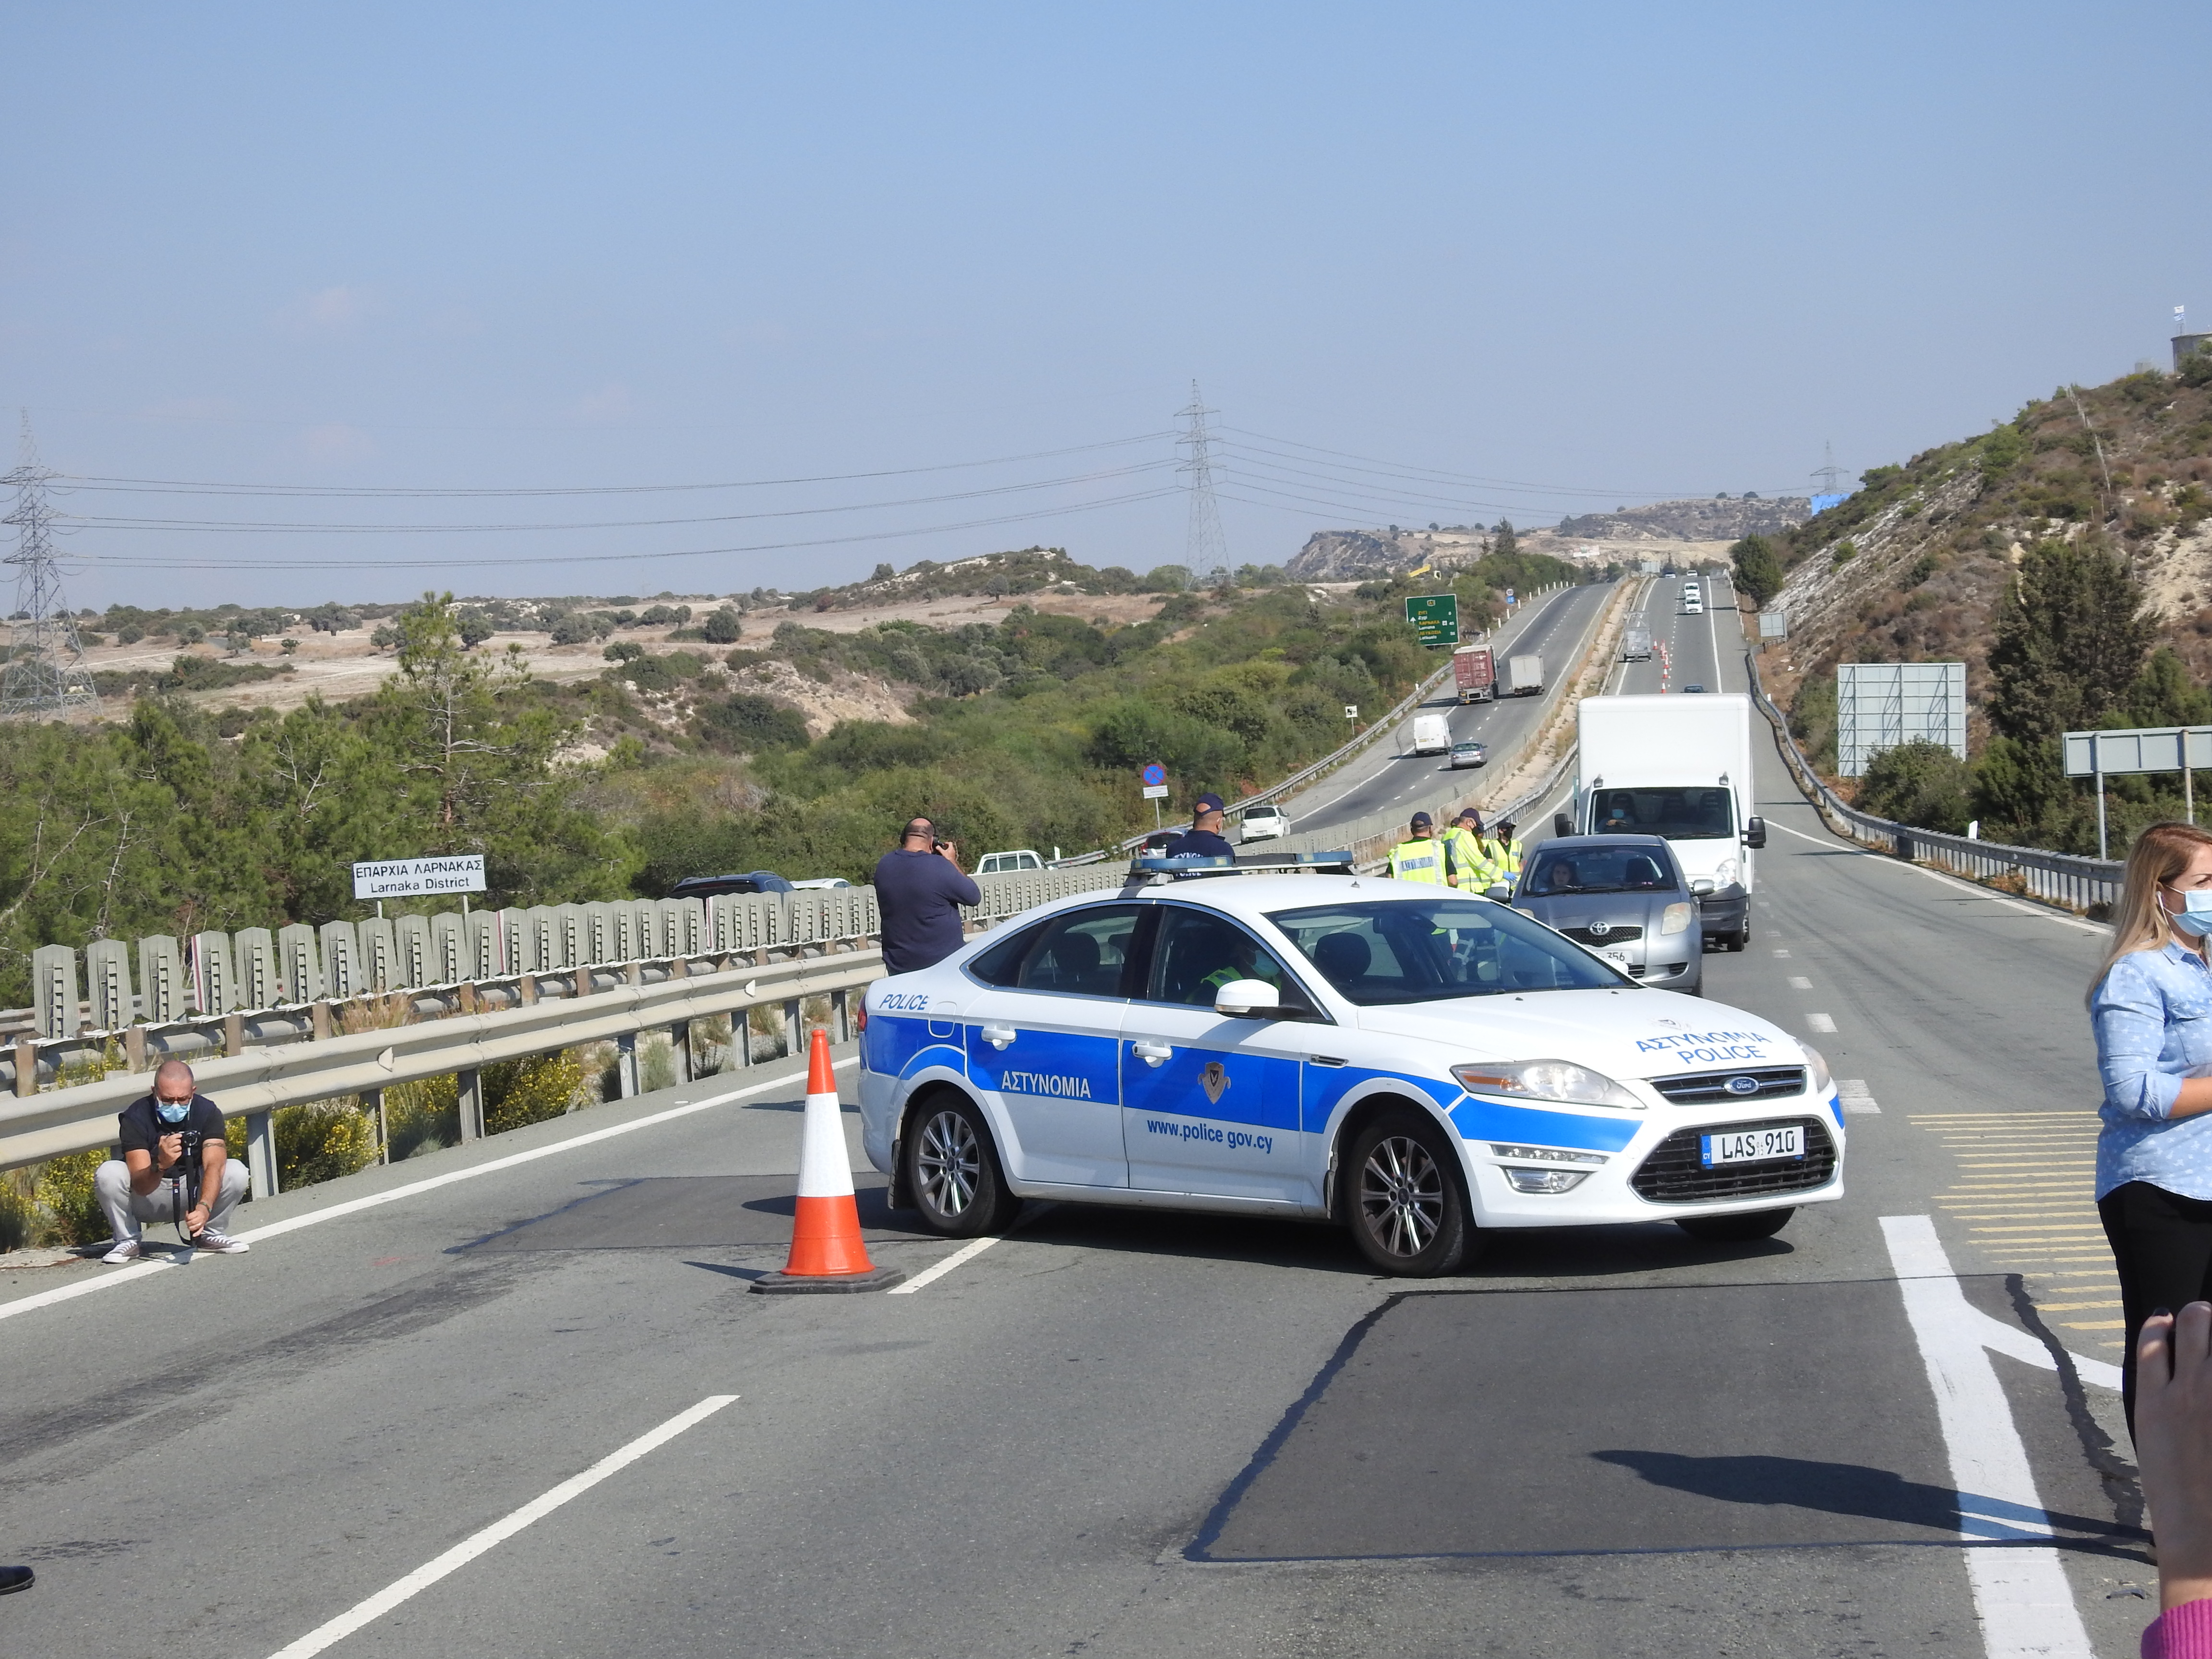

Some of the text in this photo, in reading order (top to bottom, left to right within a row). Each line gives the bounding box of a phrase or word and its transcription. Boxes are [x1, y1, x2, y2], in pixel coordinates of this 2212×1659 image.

[356, 860, 482, 878] ΕΠΑΡΧΙΑ ΛΑΡΝΑΚΑΣ
[371, 877, 470, 893] Larnaka District
[878, 994, 929, 1010] POLICE
[1635, 1032, 1773, 1052] ΑΣΤΥΝΟΜΙΑ
[1677, 1046, 1767, 1064] POLICE
[1001, 1070, 1092, 1099] ΑΣΤΥΝΟΜΙΑ
[1736, 1080, 1752, 1089] Ford
[1722, 1130, 1795, 1159] LAS 910
